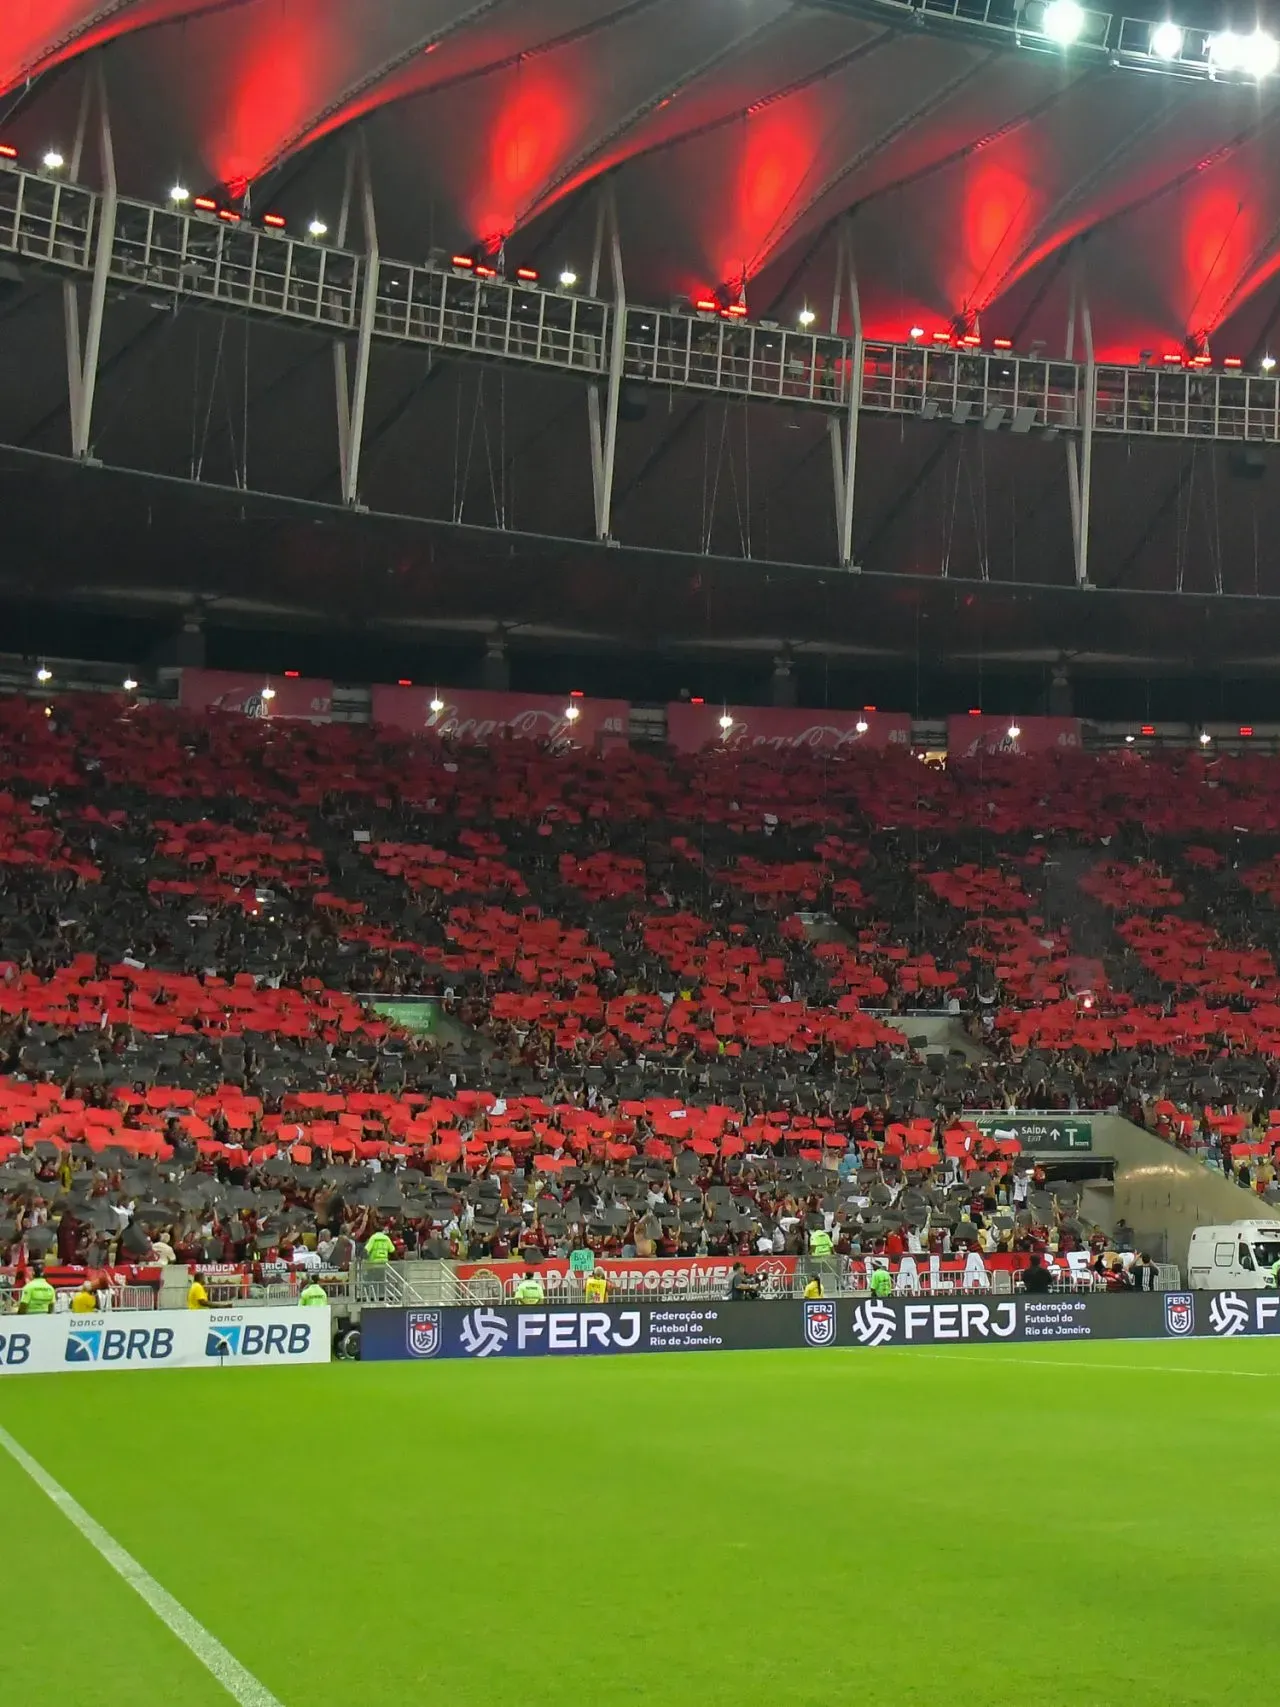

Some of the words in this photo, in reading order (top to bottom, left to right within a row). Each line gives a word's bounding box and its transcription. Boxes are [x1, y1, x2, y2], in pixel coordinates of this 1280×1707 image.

[1021, 1125, 1047, 1135] SAÍDA
[1065, 1128, 1078, 1146] T
[195, 1263, 236, 1272] SAMUCA
[1167, 1296, 1191, 1305] FERJ
[807, 1304, 833, 1313] FERJ
[1024, 1301, 1073, 1312] Federação
[1074, 1301, 1086, 1310] de
[210, 1314, 243, 1323] banco
[409, 1313, 438, 1322] FERJ
[650, 1310, 703, 1322] Federação
[704, 1309, 718, 1320] de
[904, 1302, 1017, 1339] FERJ
[1025, 1314, 1060, 1323] Futebol
[1061, 1313, 1073, 1322] do
[69, 1318, 105, 1328] banco
[650, 1323, 688, 1333] Futebol
[689, 1323, 703, 1332] do
[517, 1311, 642, 1350] FERJ
[1025, 1327, 1041, 1336] Rio
[1041, 1326, 1054, 1335] de
[1055, 1325, 1091, 1335] Janeiro
[101, 1327, 174, 1361] BRB
[241, 1323, 311, 1355] BRB
[650, 1337, 667, 1346] Rio
[668, 1336, 681, 1346] de
[683, 1335, 723, 1345] Janeiro
